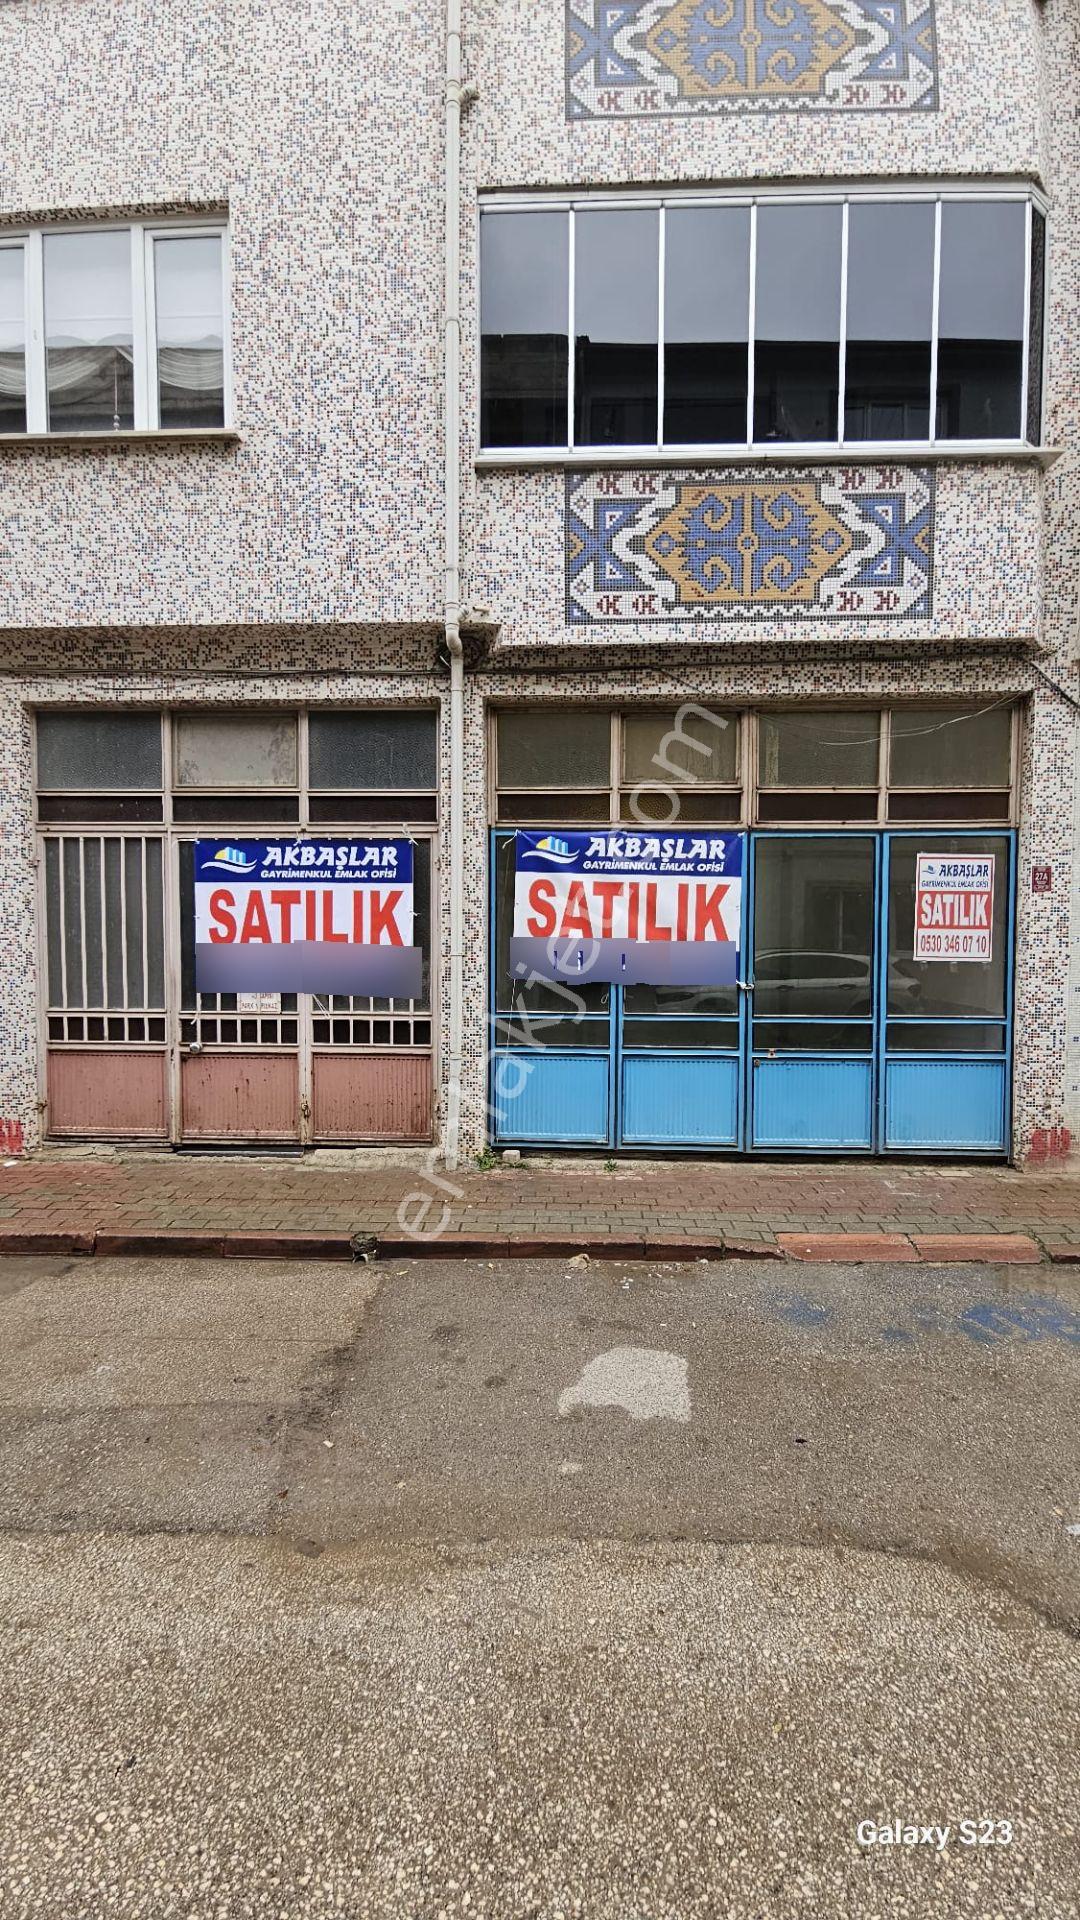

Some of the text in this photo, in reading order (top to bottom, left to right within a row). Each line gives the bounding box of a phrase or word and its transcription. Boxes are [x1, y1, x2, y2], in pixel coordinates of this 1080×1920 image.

[261, 846, 398, 870] AKBAŞLAR
[585, 837, 726, 862] AKBAŞLAR
[260, 867, 397, 878] GAYRİMENKUL EMLAK OFİSİ
[582, 859, 724, 873] GAYRİMENKUL EMLAK OFİSİ
[939, 864, 988, 879] AKBAŞLAR
[208, 889, 405, 946] SATILIK
[527, 879, 732, 942] SATILIK
[921, 893, 989, 926] SATILIK
[921, 935, 986, 953] 0530 346 07 10
